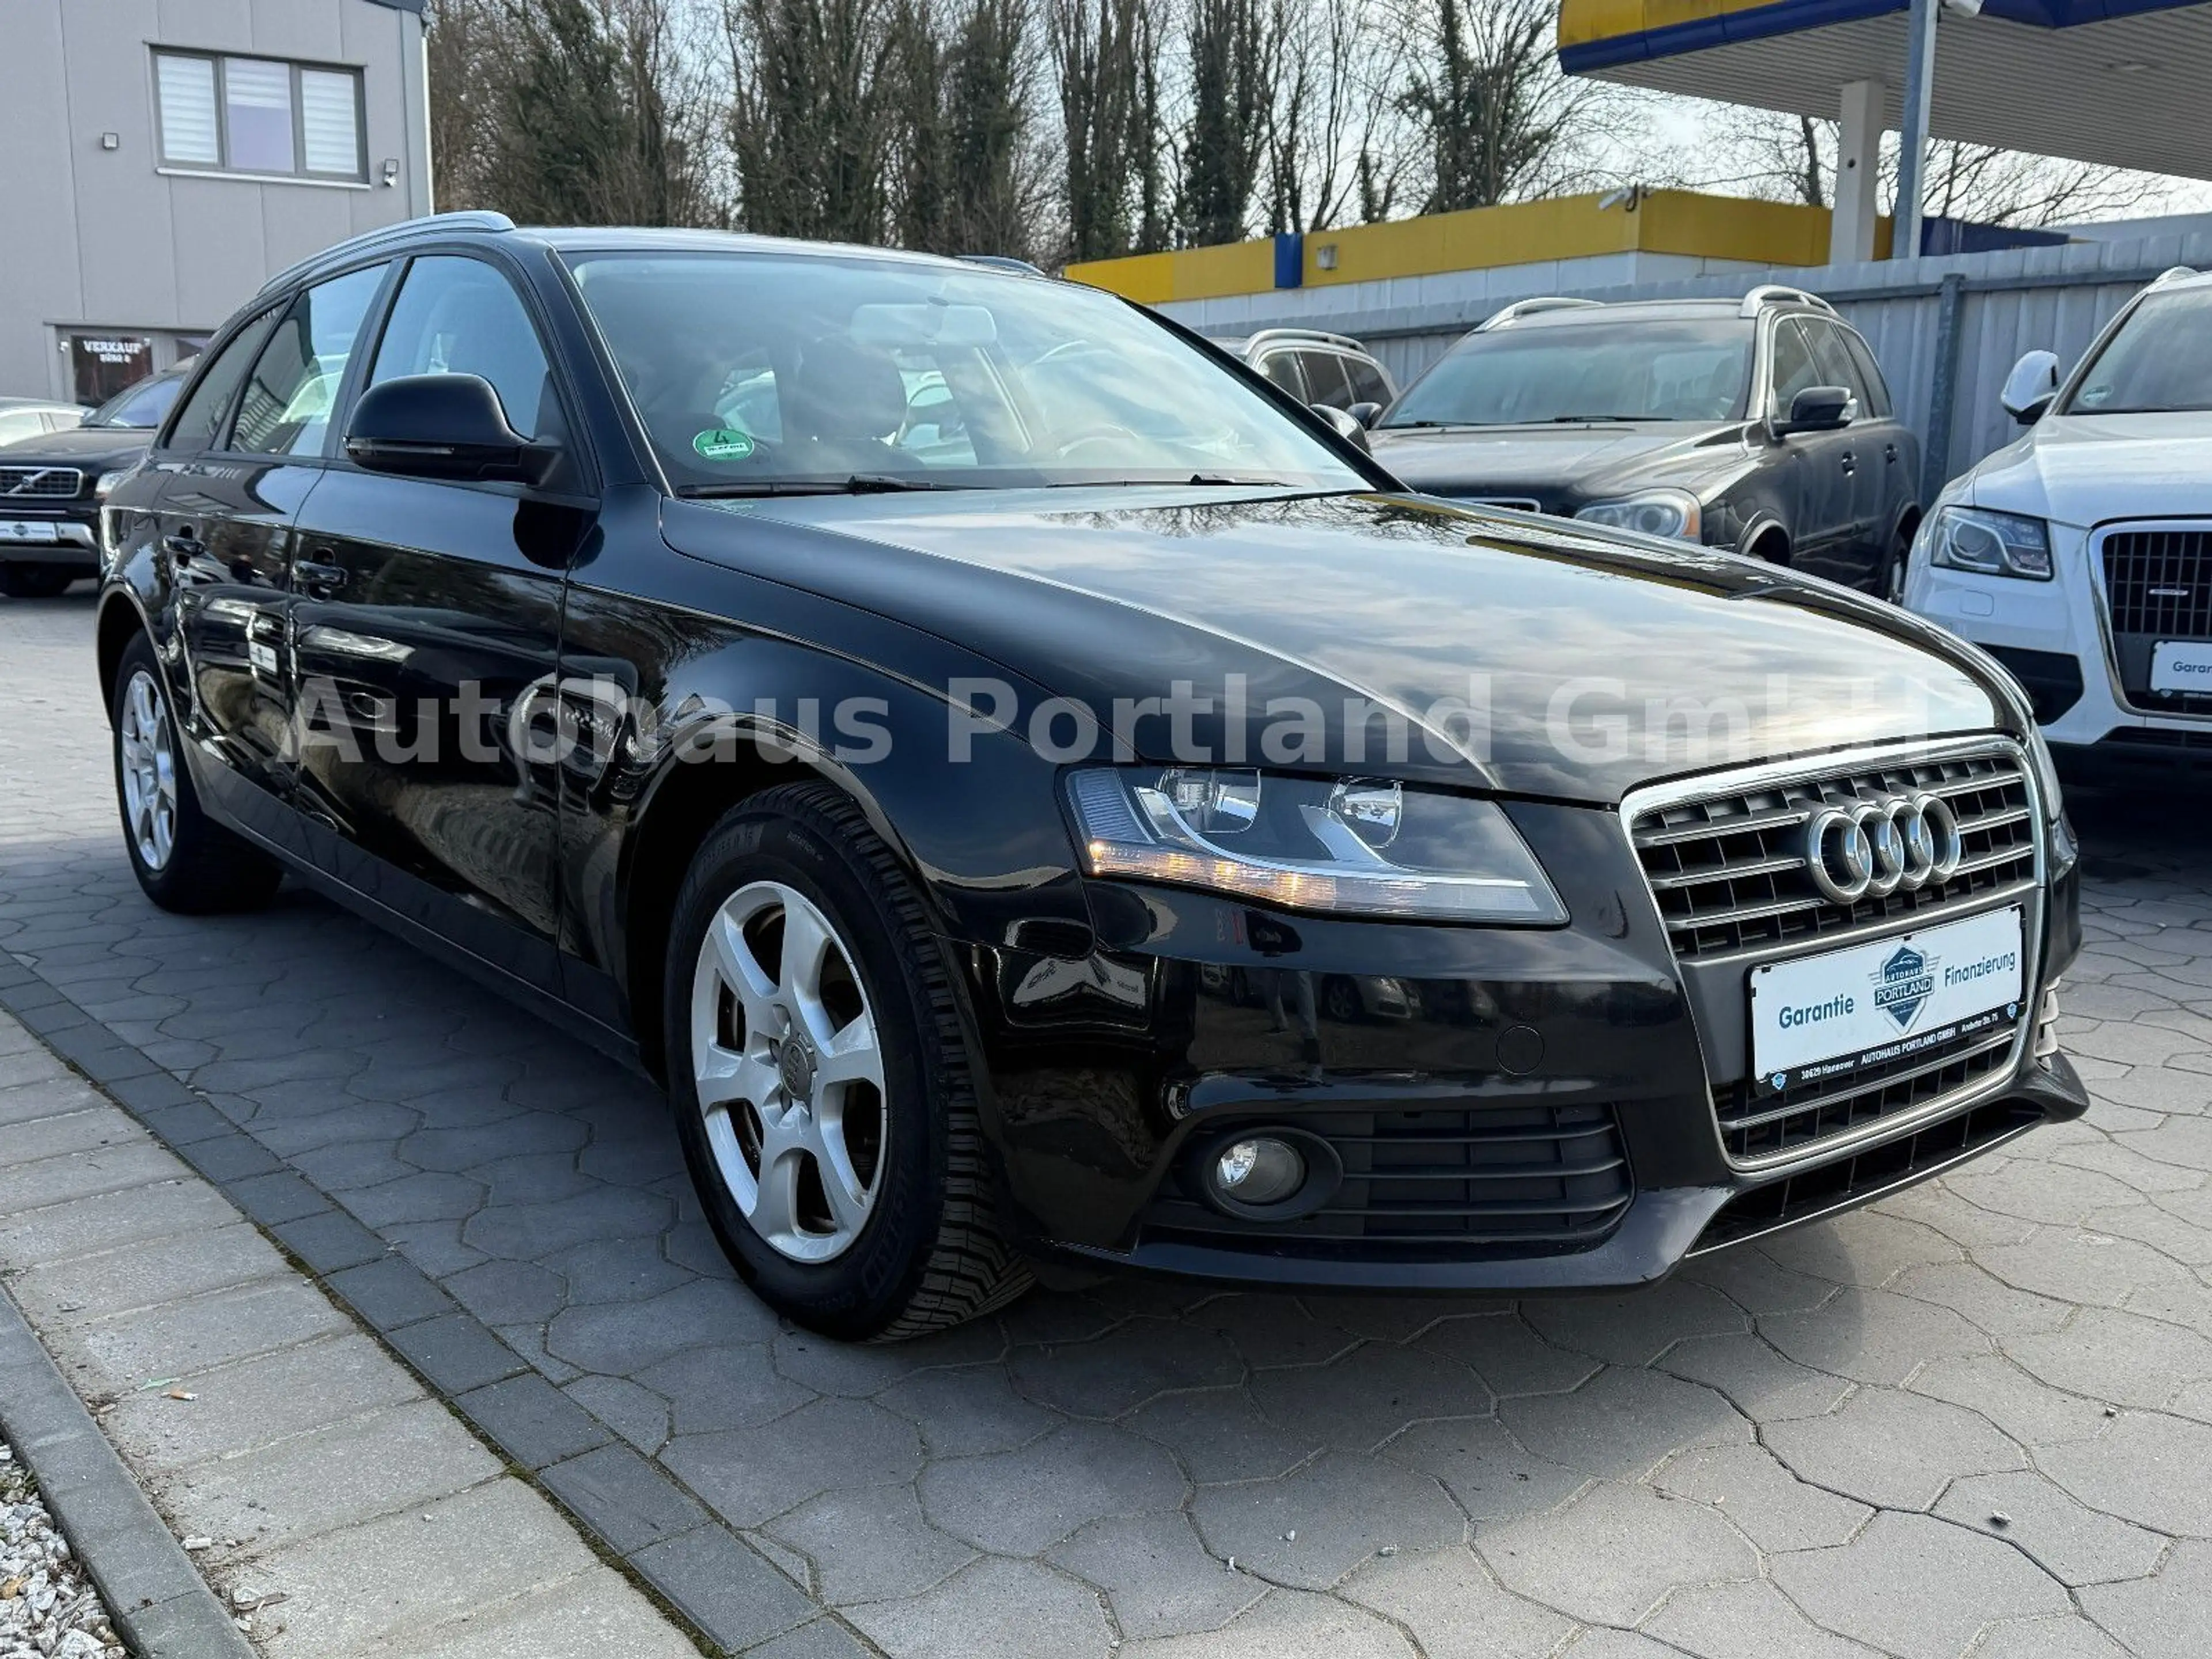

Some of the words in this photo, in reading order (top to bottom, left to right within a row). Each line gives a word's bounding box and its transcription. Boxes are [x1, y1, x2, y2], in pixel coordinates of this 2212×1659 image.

[83, 340, 142, 354] VERKAUF
[714, 431, 729, 444] 4
[1945, 952, 2015, 987] Finanzierung
[1877, 979, 1931, 1003] PORTLAND
[1779, 994, 1854, 1029] Garantie
[1861, 1044, 1900, 1065] AUTOHAUS
[1902, 1033, 1936, 1052] PORTLAND
